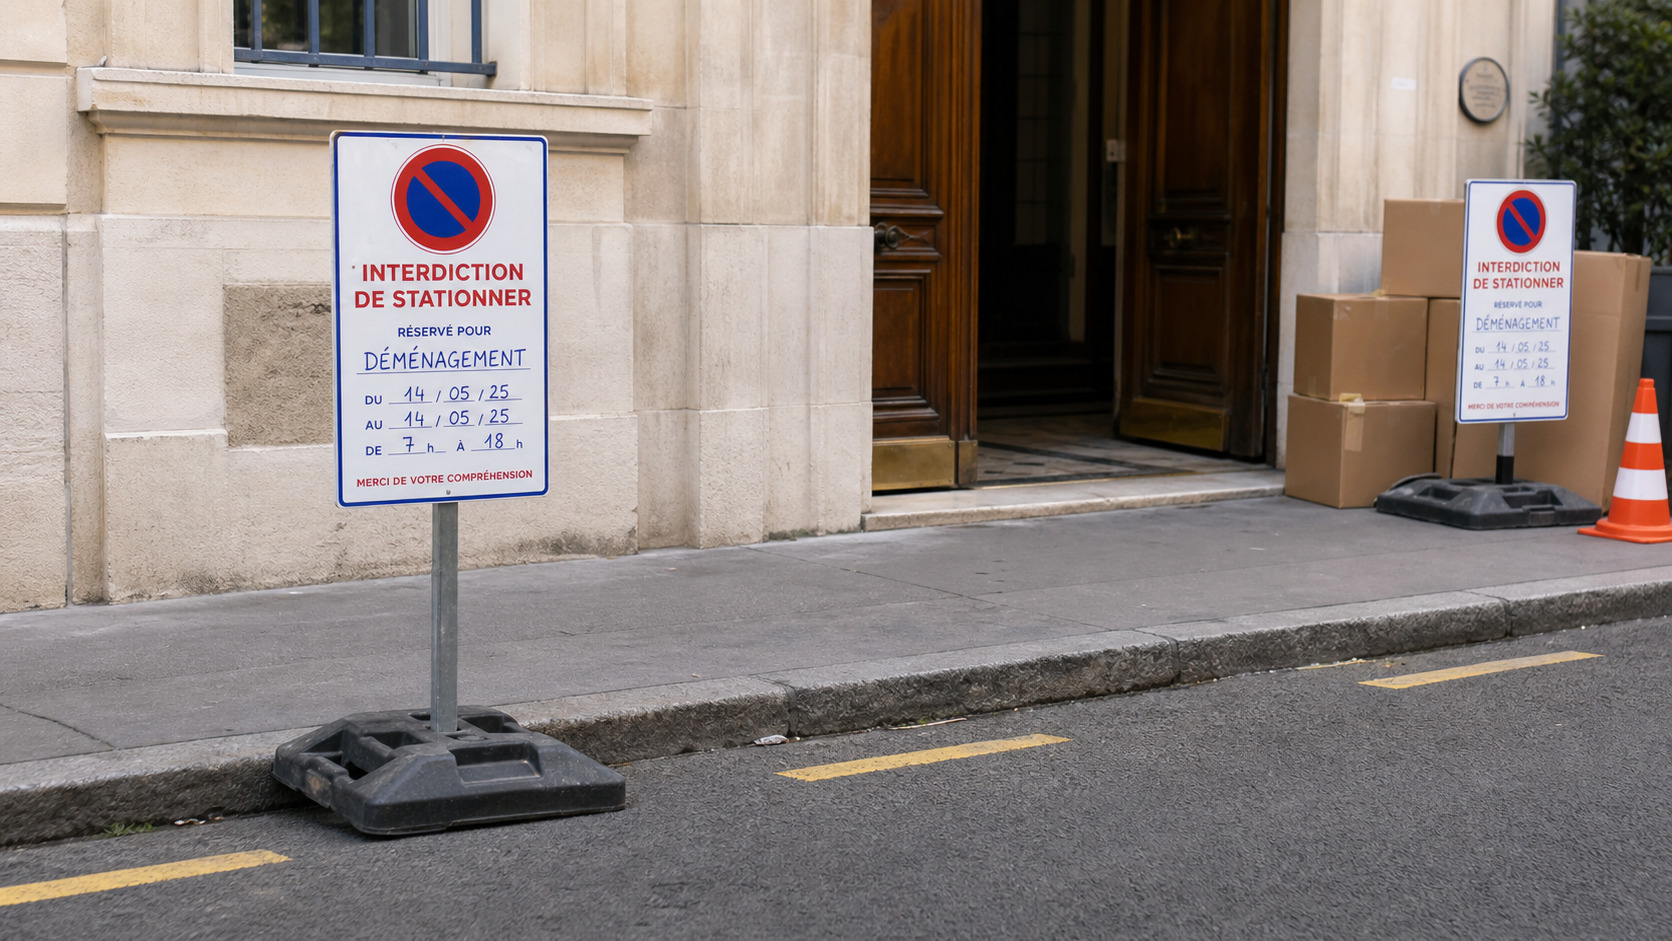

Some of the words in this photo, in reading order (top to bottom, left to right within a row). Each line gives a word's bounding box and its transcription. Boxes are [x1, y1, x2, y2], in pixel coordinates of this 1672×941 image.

[362, 262, 524, 282] INTERDICTION
[1477, 261, 1560, 273] INTERDICTION
[1473, 278, 1489, 290] DE
[1492, 277, 1564, 289] STATIONNER
[354, 290, 385, 308] DE
[392, 289, 532, 308] STATIONNER
[1523, 300, 1543, 309] POUR
[397, 324, 454, 338] RÉSERVÉ
[457, 325, 492, 336] POUR
[1475, 314, 1561, 331] DÉMÉNAGEMENT
[363, 345, 527, 371] DÉMÉNAGEMENT
[1475, 346, 1486, 354] DU
[1474, 363, 1485, 371] AU
[1473, 381, 1483, 390] DE
[364, 395, 383, 406] DU
[404, 385, 425, 402] 14
[449, 385, 470, 401] 05
[489, 384, 509, 400] 25
[365, 420, 383, 431] AU
[404, 410, 425, 427] 14
[449, 410, 470, 425] 05
[489, 408, 510, 424] 25
[365, 445, 383, 456] DE
[402, 436, 415, 453] 7
[483, 432, 504, 449] 18
[356, 477, 390, 488] MERCI
[393, 476, 407, 486] DE
[409, 475, 444, 486] VOTRE
[446, 468, 534, 484] COMPRÉHENSION
